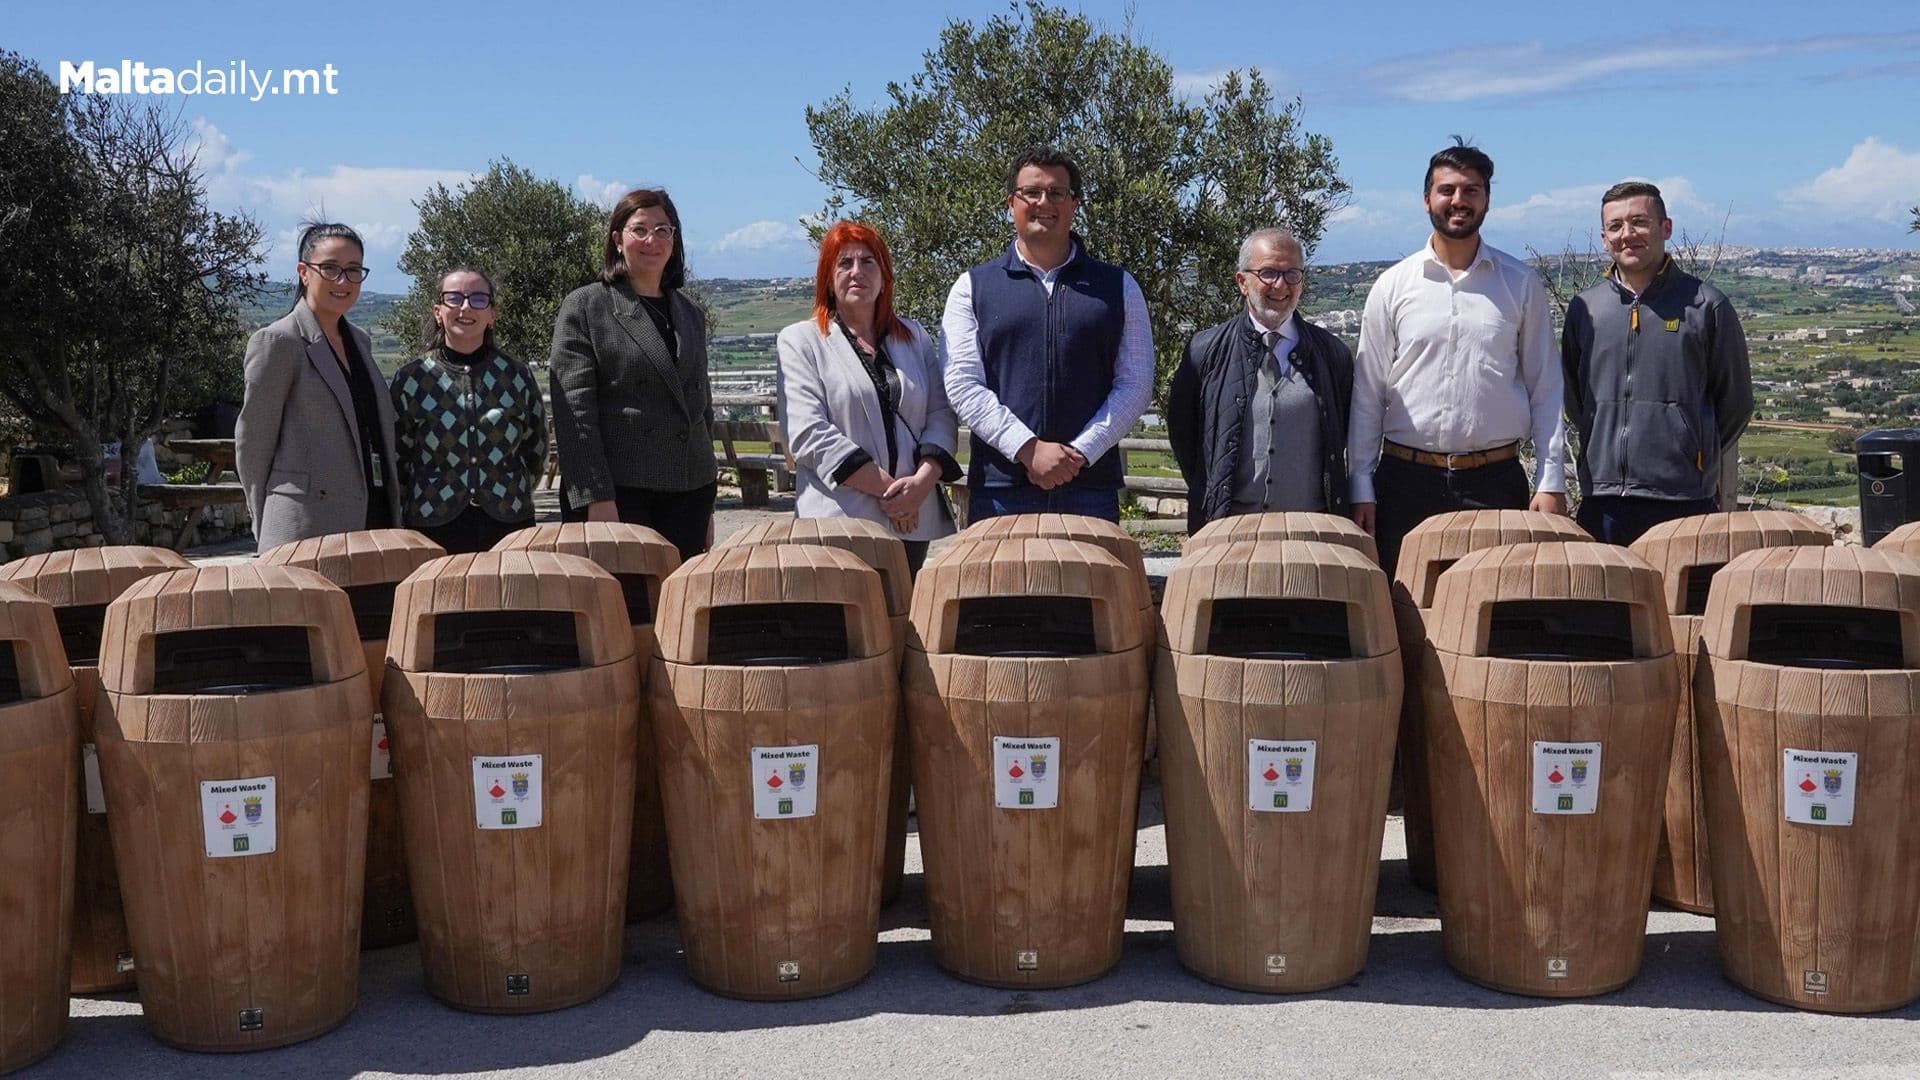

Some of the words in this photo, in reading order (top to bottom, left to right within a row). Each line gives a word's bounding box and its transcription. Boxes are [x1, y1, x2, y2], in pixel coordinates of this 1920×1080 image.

[1002, 742, 1026, 750] Mixed
[1257, 744, 1281, 752] Mixed
[760, 751, 785, 759] Mixed
[785, 750, 811, 758] Waste
[1793, 754, 1819, 763] Mixed
[1820, 757, 1848, 765] Waste
[507, 760, 533, 768] Waste
[210, 784, 238, 793] Mixed
[238, 783, 267, 792] Waste
